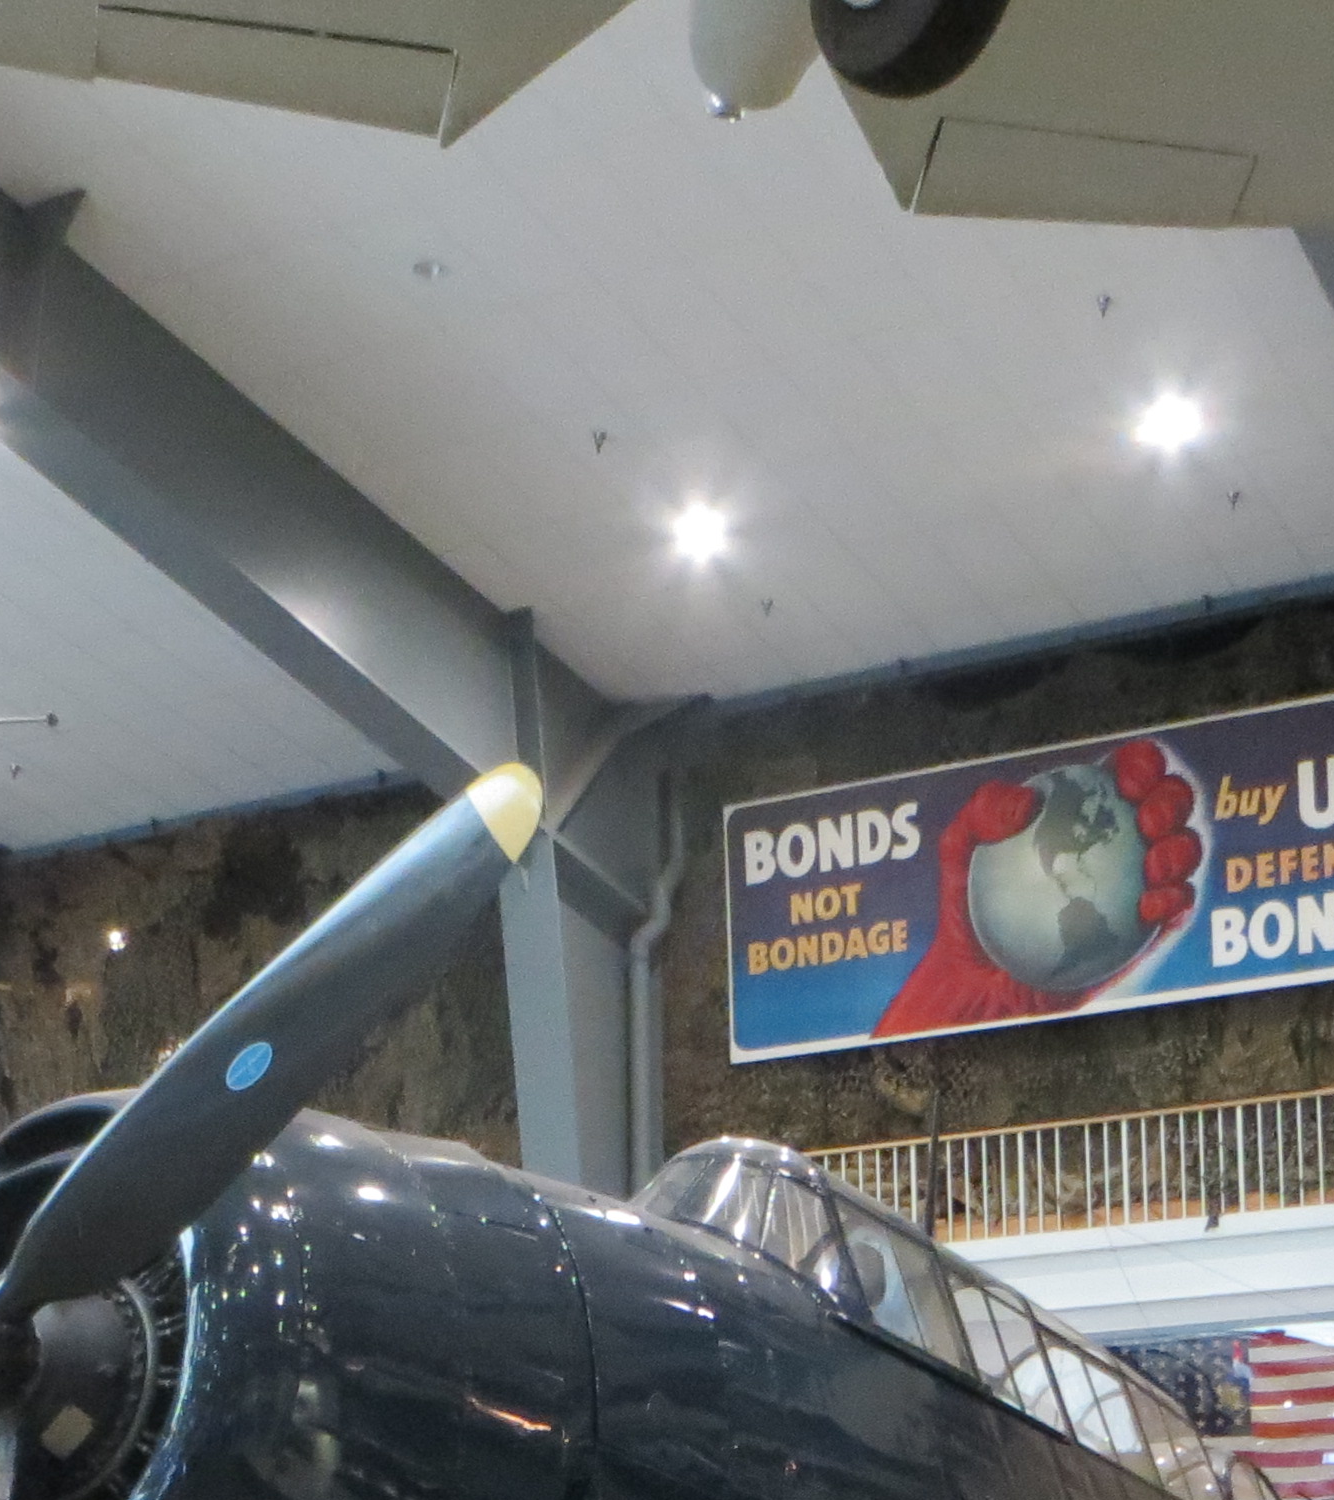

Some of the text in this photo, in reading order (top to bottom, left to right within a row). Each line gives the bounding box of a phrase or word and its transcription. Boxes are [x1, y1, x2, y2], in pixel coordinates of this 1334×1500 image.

[1215, 775, 1288, 826] buy
[744, 802, 921, 887] BONDS
[790, 882, 862, 926] NOT
[747, 919, 908, 976] BONDAGE
